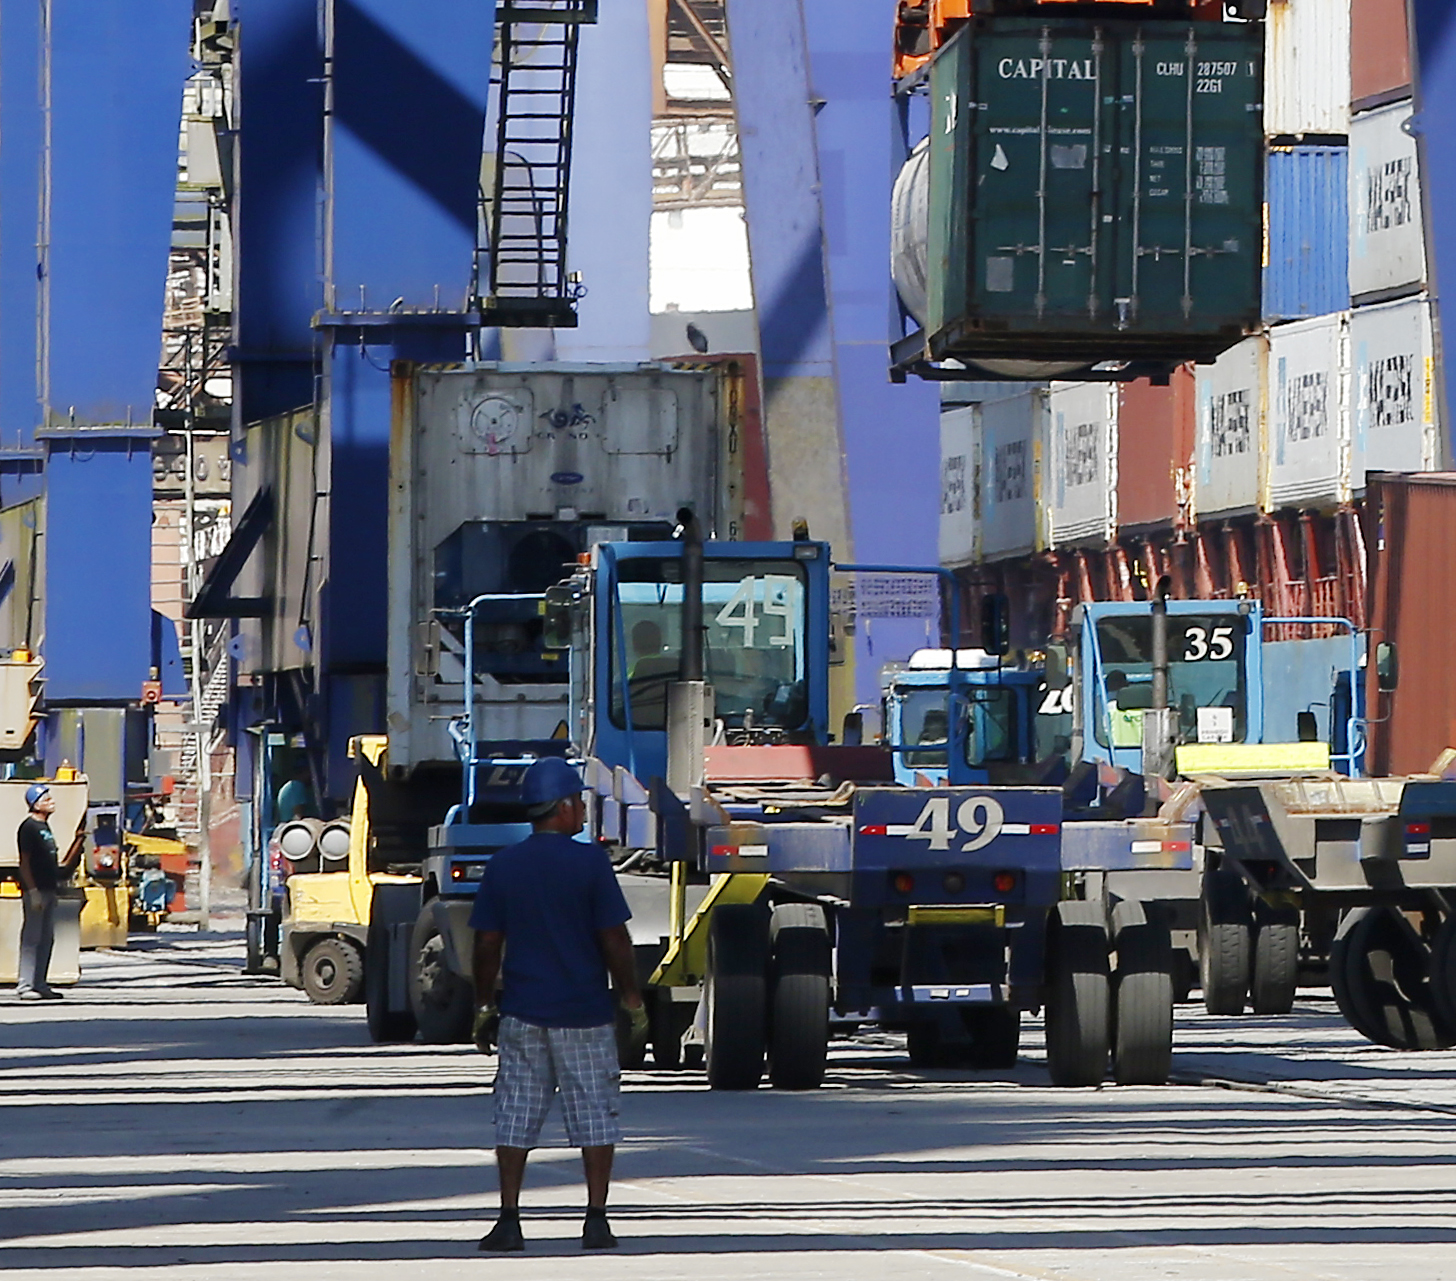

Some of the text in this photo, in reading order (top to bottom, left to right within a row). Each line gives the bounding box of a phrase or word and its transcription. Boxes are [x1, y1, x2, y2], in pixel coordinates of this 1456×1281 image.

[998, 58, 1098, 80] CAPITAL
[1156, 62, 1184, 76] CLHU
[1197, 62, 1238, 76] 287507
[1196, 79, 1223, 92] 22G1
[715, 574, 797, 647] 49
[1184, 626, 1234, 661] 35
[905, 795, 1005, 852] 49
